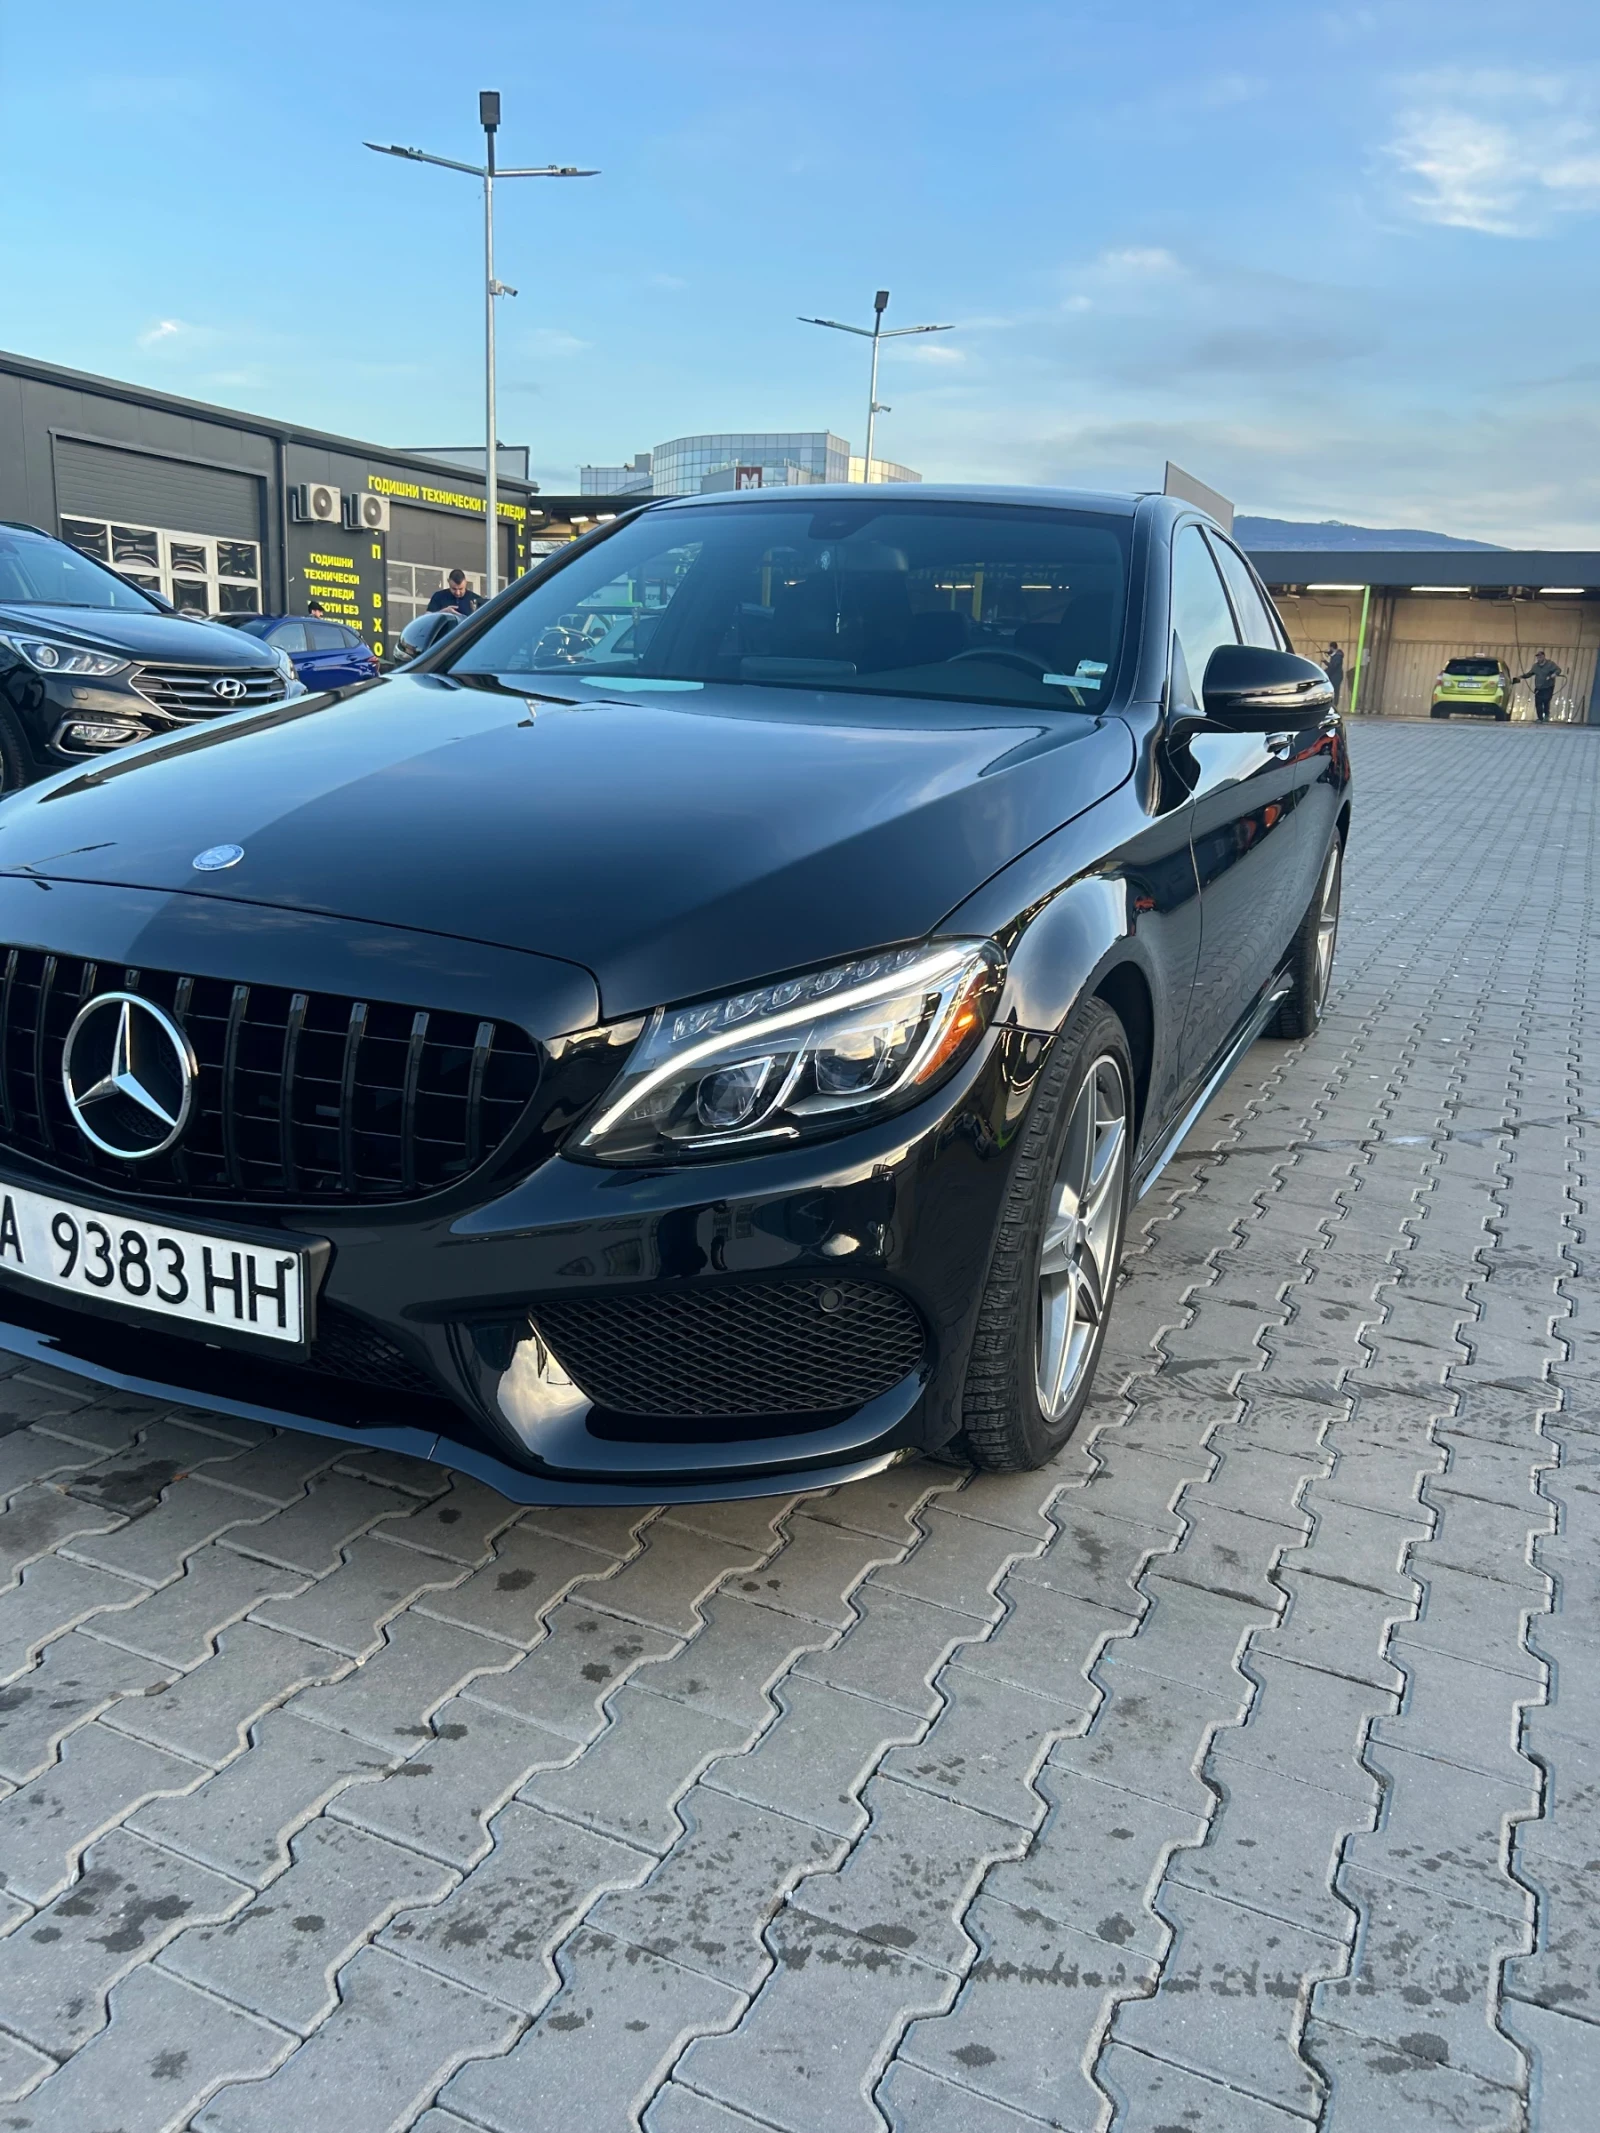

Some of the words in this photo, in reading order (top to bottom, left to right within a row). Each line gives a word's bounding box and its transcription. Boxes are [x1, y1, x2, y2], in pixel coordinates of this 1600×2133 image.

[368, 475, 419, 499] ГОДИШНИ
[421, 486, 481, 512] ТЕХНИЧЕСКИ
[310, 552, 354, 569] ГОДИШНИ
[303, 568, 360, 585] ТЕХНИЧЕСКИ
[310, 585, 355, 600] ПРЕГЛЕДИ
[343, 604, 360, 616] БЕЗ
[0, 1194, 24, 1264] A
[52, 1211, 189, 1305] 9383
[202, 1245, 288, 1329] HH
